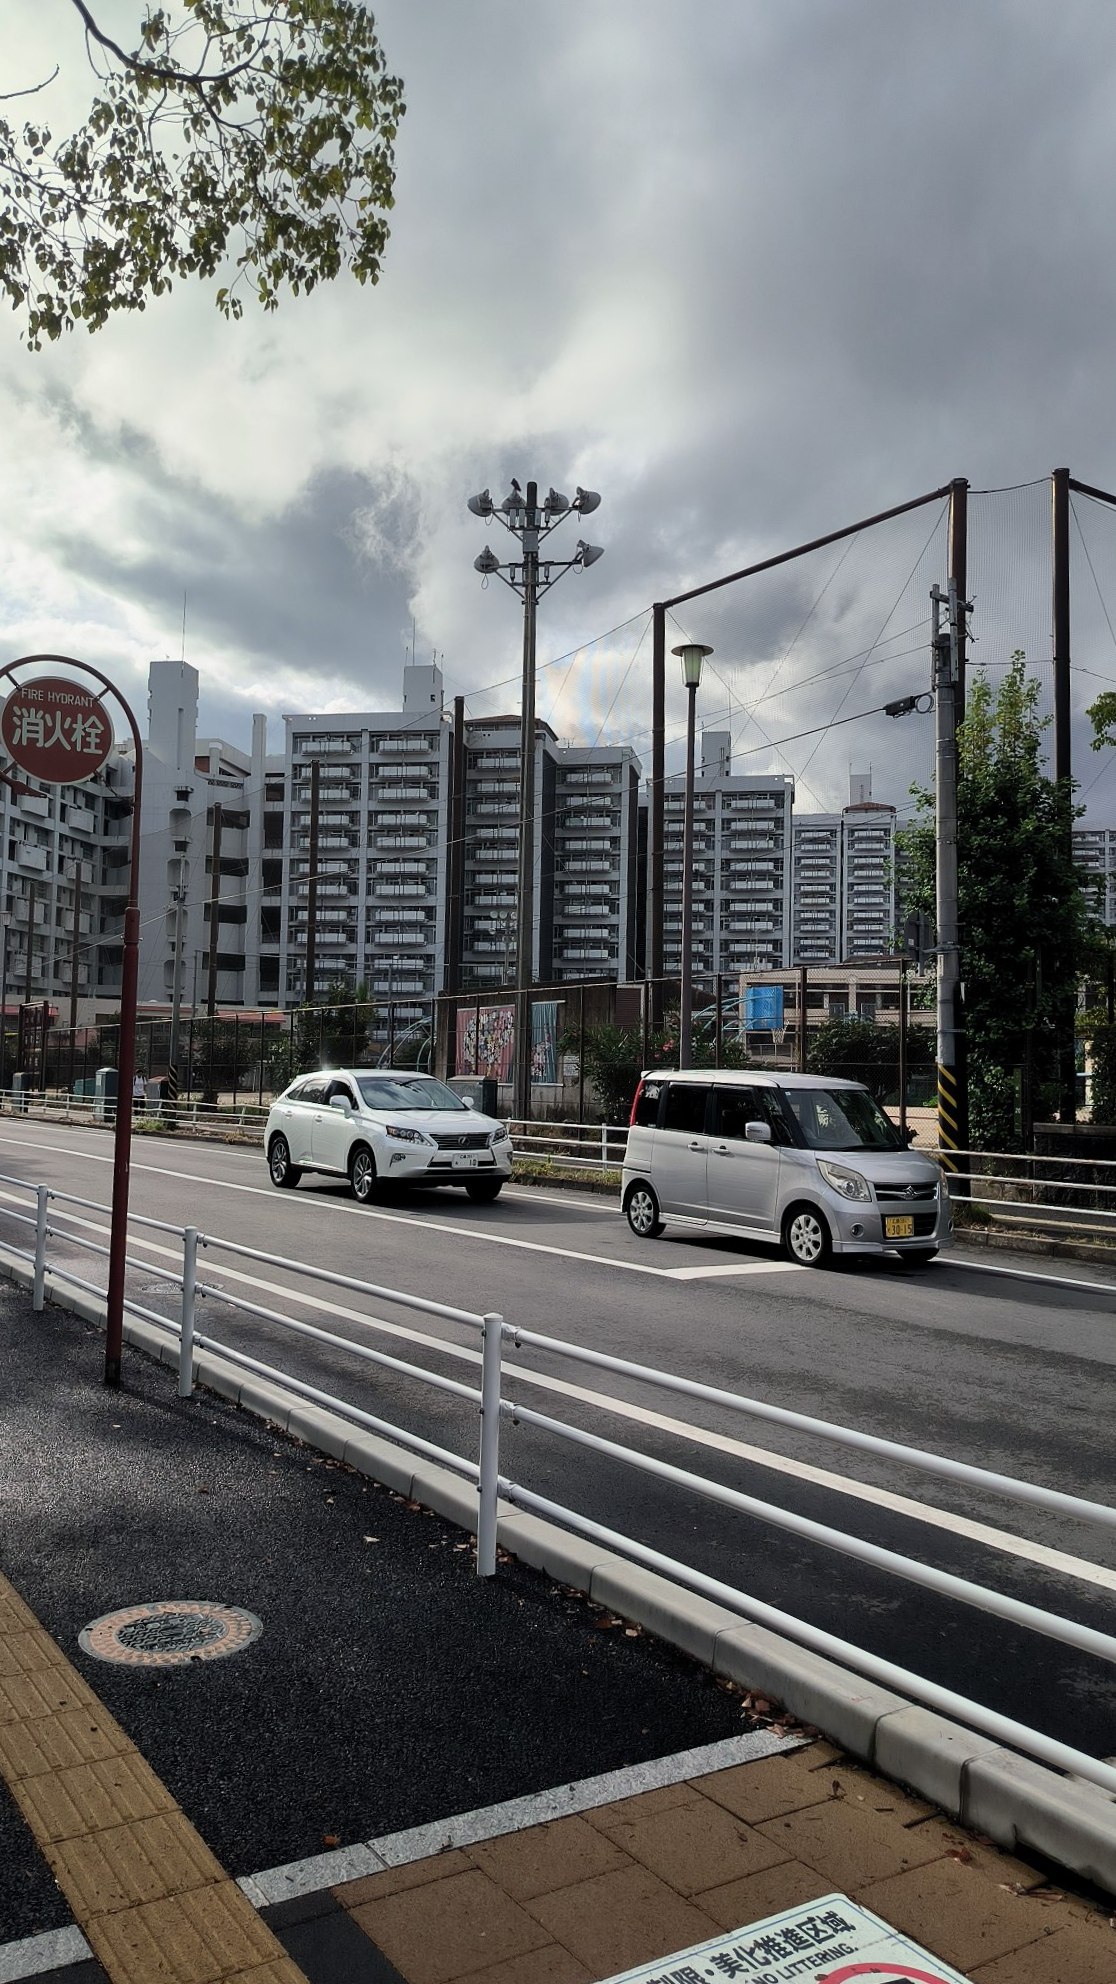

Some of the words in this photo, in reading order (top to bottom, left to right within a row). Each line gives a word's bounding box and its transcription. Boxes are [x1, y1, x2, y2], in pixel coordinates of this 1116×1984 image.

[21, 688, 44, 701] FIRE
[48, 691, 95, 708] HYDRANT
[12, 705, 105, 754] 消火栓
[751, 1973, 779, 1984] NO
